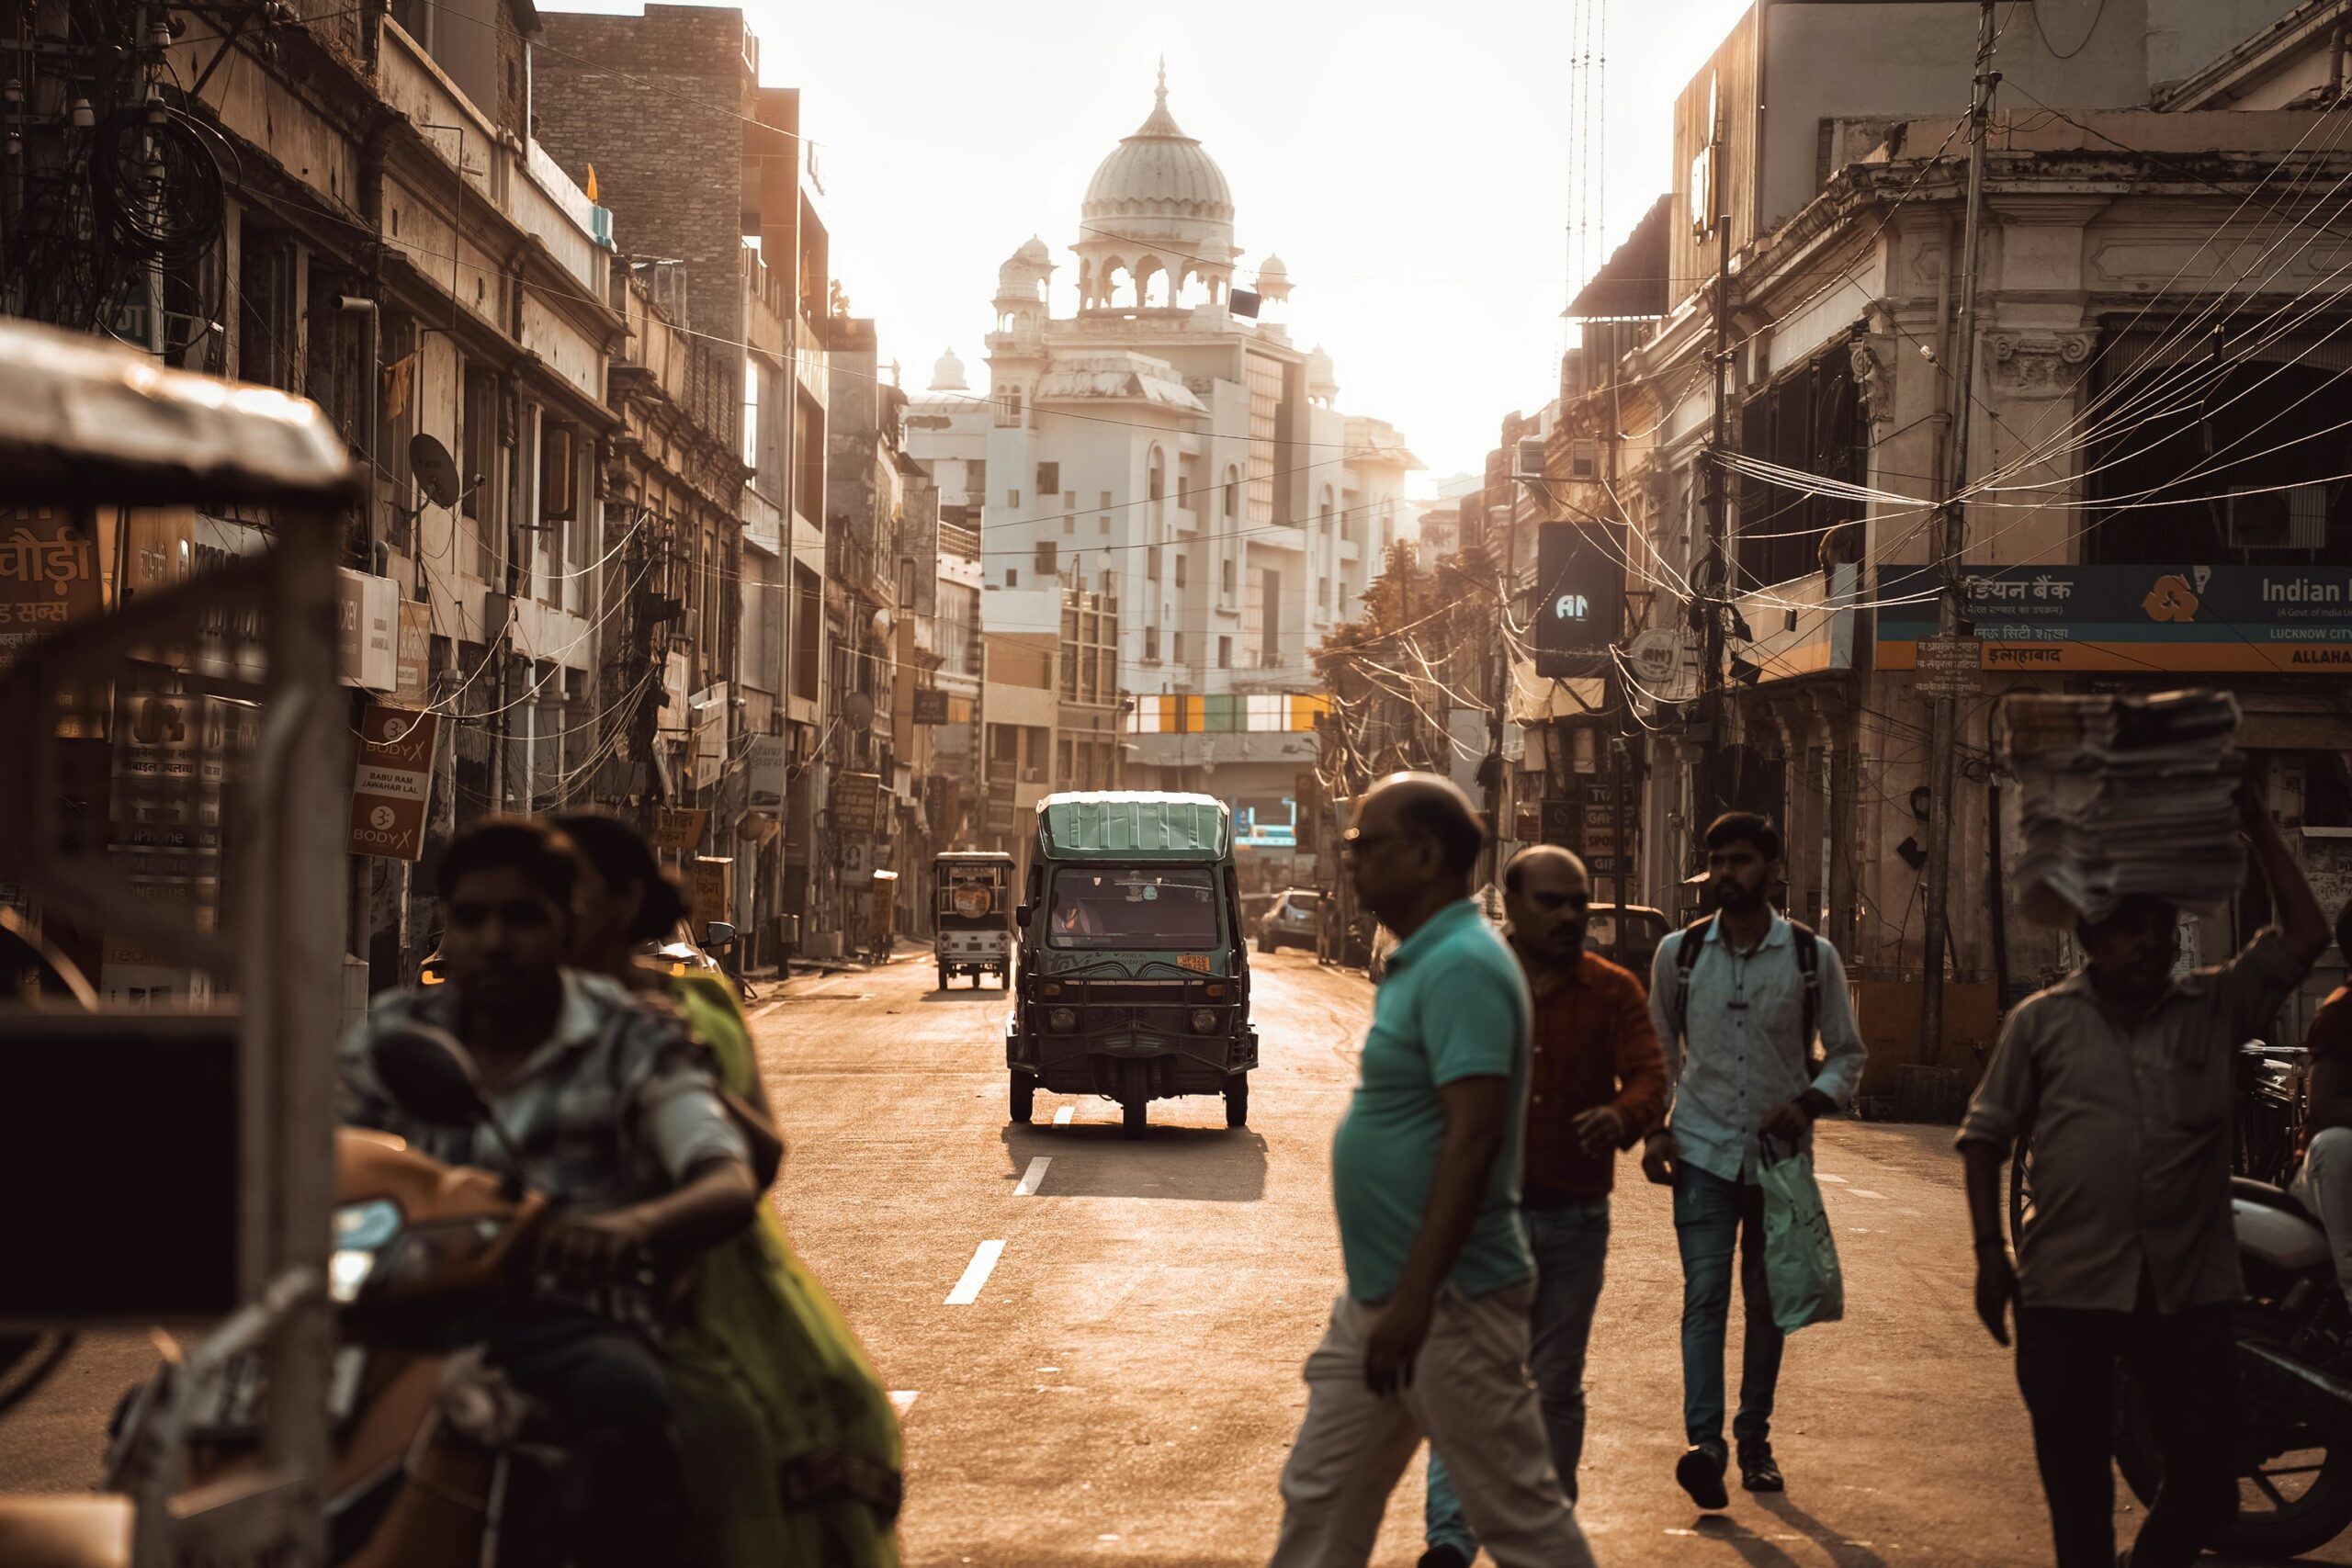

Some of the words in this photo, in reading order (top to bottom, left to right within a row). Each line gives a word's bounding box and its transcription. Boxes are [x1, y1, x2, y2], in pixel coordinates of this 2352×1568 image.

[2032, 575, 2074, 600] बैंक
[2263, 578, 2340, 602] Indian
[16, 602, 68, 622] सन्स
[2311, 608, 2320, 616] of
[2321, 608, 2342, 616] India
[2003, 625, 2030, 639] सिटी
[2270, 629, 2326, 639] LUCKNOW
[1988, 647, 2063, 663] इलाहाबाद
[369, 772, 393, 783] BABU
[395, 776, 413, 784] RAM
[361, 780, 401, 791] JAWAHAR
[403, 785, 419, 794] LAL
